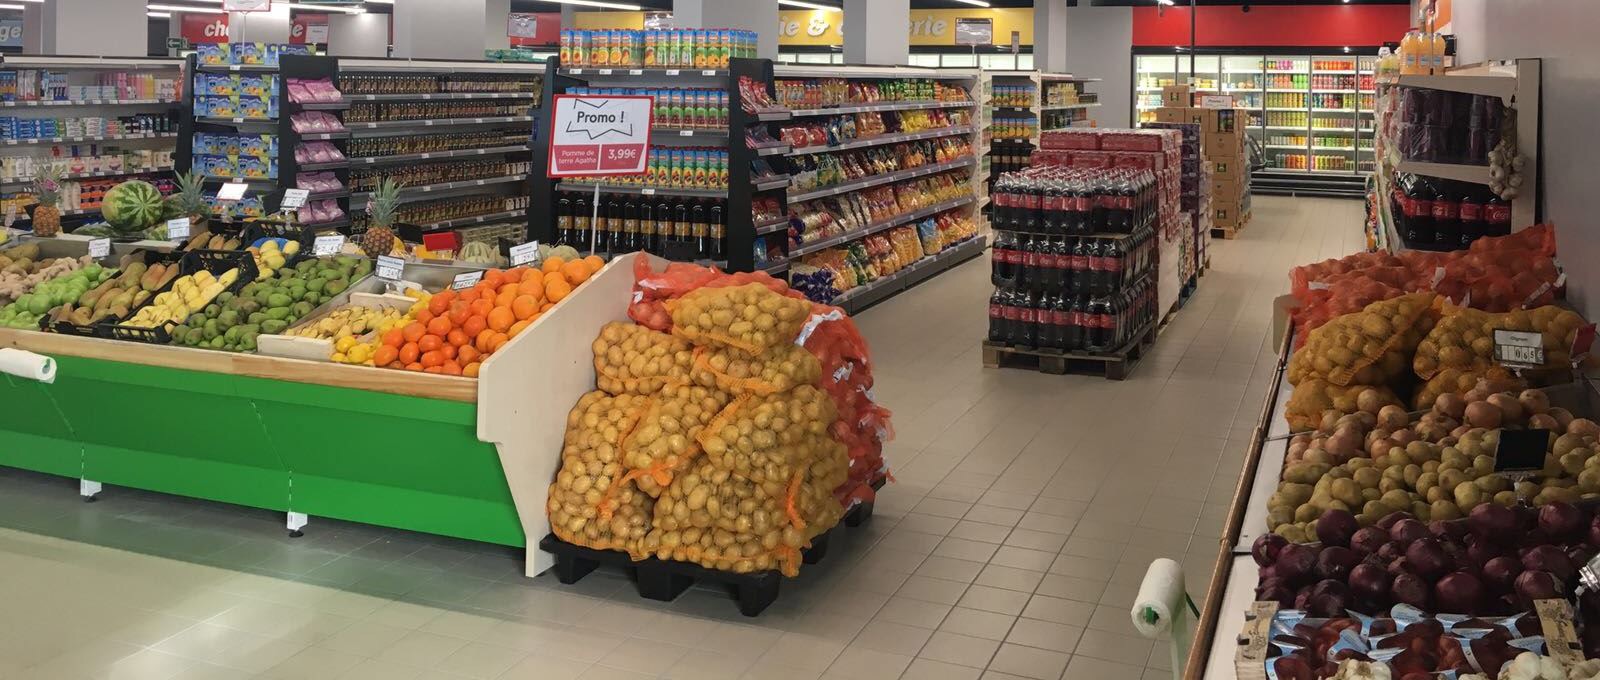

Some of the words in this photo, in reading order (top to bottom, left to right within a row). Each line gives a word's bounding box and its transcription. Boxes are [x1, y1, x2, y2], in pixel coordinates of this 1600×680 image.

[807, 13, 830, 37] &
[910, 15, 948, 37] rie
[0, 26, 24, 42] ge
[576, 111, 616, 123] Promo
[620, 111, 625, 122] !
[587, 149, 595, 157] de
[608, 148, 637, 161] 3,99€
[558, 157, 574, 165] terre
